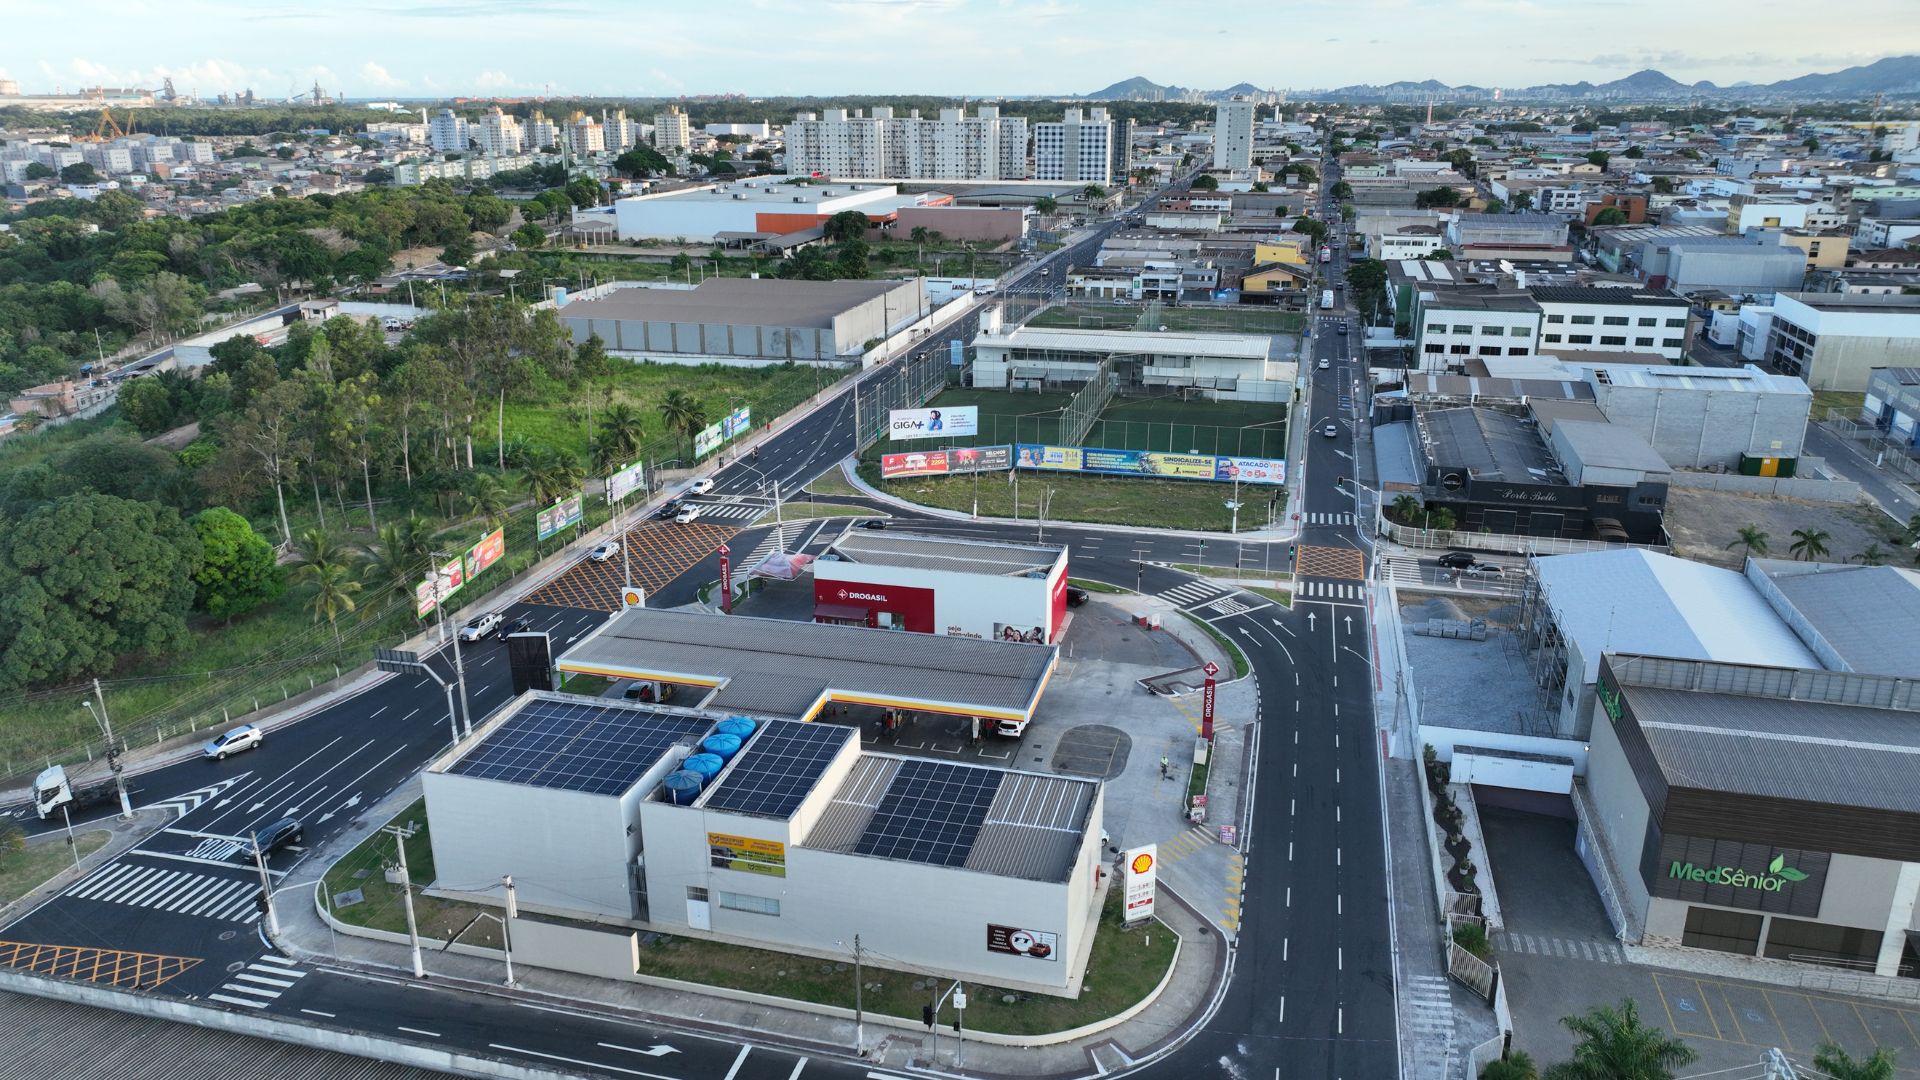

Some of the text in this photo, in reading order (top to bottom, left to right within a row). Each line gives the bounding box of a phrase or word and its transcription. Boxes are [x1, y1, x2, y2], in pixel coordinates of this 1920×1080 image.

[1163, 456, 1212, 465] SINDICALIZE-SE
[1238, 461, 1269, 469] ATACADO
[1502, 489, 1557, 502] Porto Bello
[721, 562, 729, 591] DROGASIL
[849, 592, 888, 602] DROGASIL
[947, 630, 983, 639] bem-vindo
[1205, 685, 1213, 718] DROGASIL
[1669, 861, 1787, 892] MedSênior
